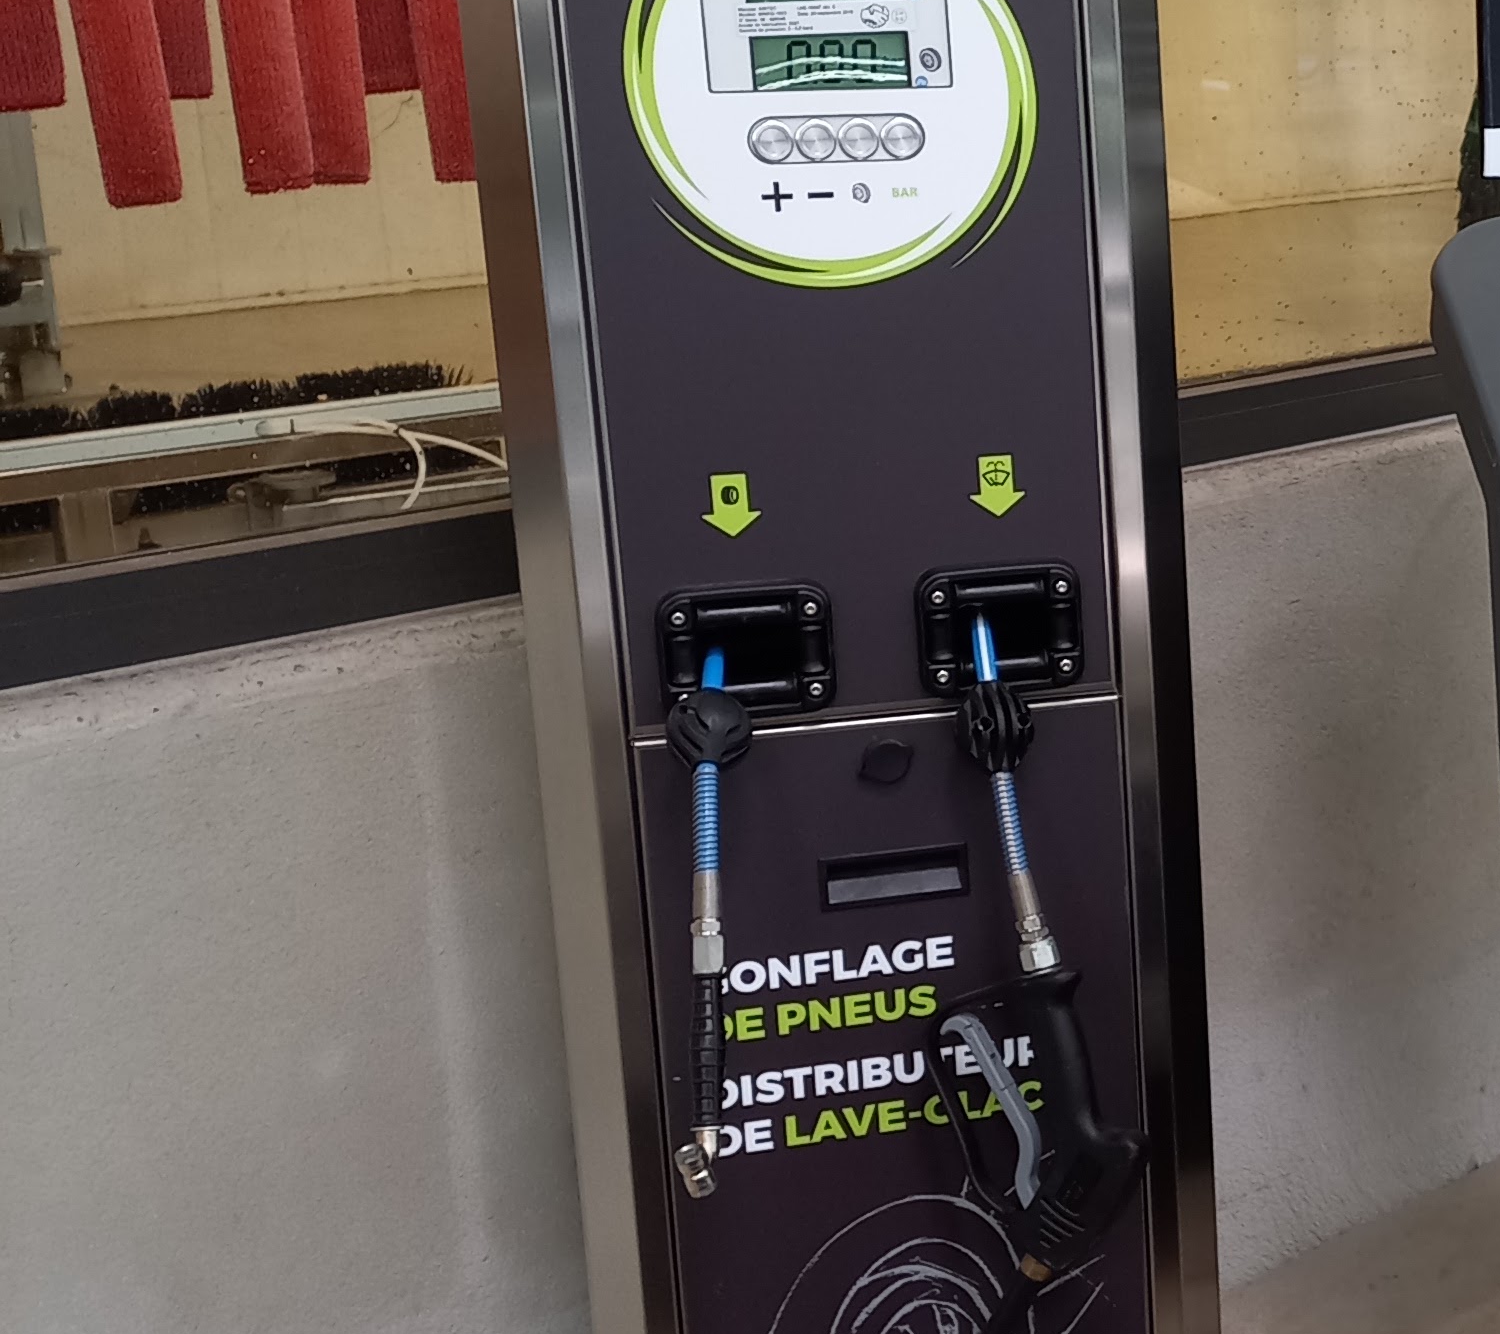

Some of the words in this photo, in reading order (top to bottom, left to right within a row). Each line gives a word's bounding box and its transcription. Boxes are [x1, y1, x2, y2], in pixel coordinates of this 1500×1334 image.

[891, 187, 919, 199] BAR
[721, 934, 955, 995] ONFLAGE
[724, 1007, 766, 1041] E
[777, 984, 937, 1036] PNEUS
[785, 1080, 1045, 1147] LAVE-GLAC
